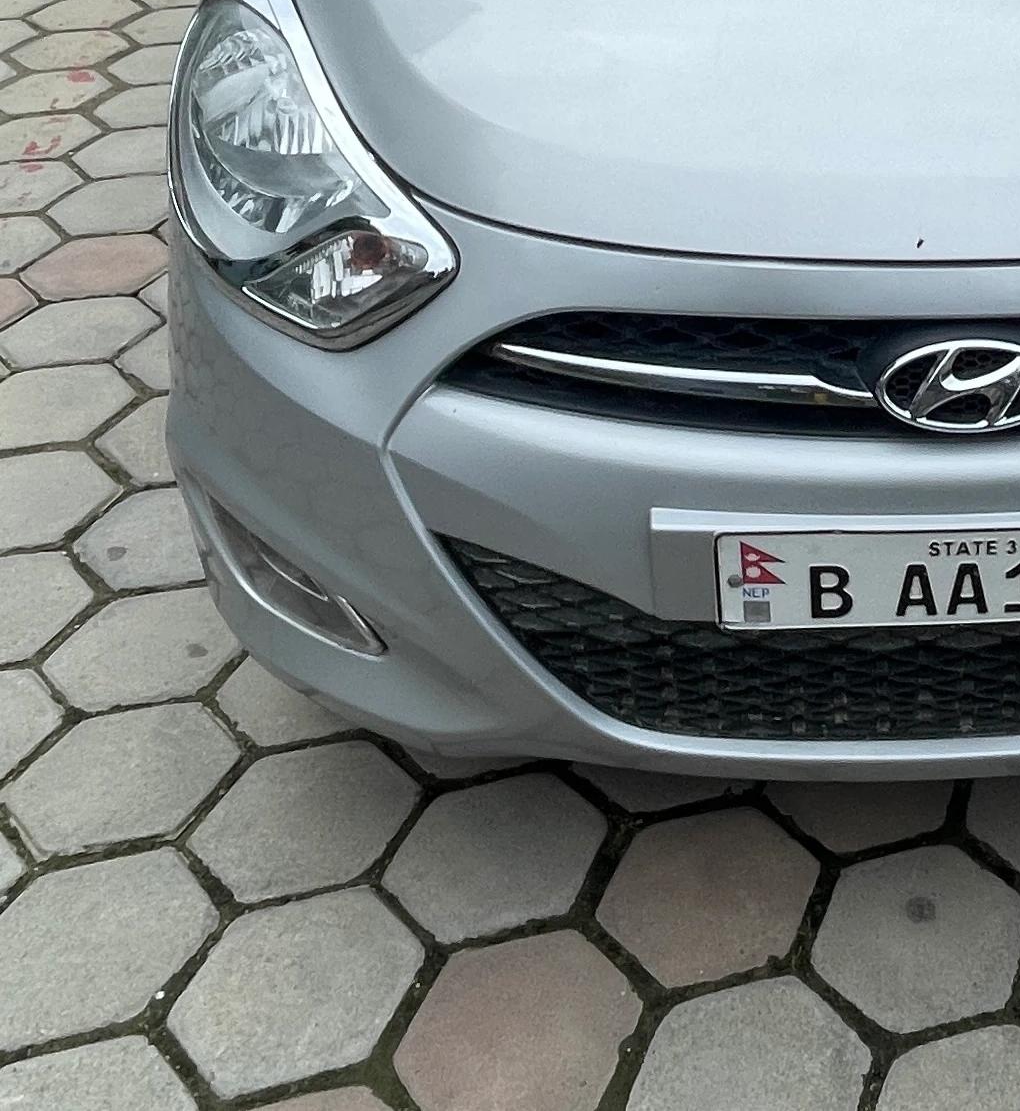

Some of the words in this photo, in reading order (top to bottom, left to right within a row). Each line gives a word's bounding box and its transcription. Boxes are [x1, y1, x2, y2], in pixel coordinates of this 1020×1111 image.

[928, 540, 998, 557] STATE
[1005, 539, 1018, 555] 3
[742, 588, 770, 598] NEP
[809, 565, 853, 619] B
